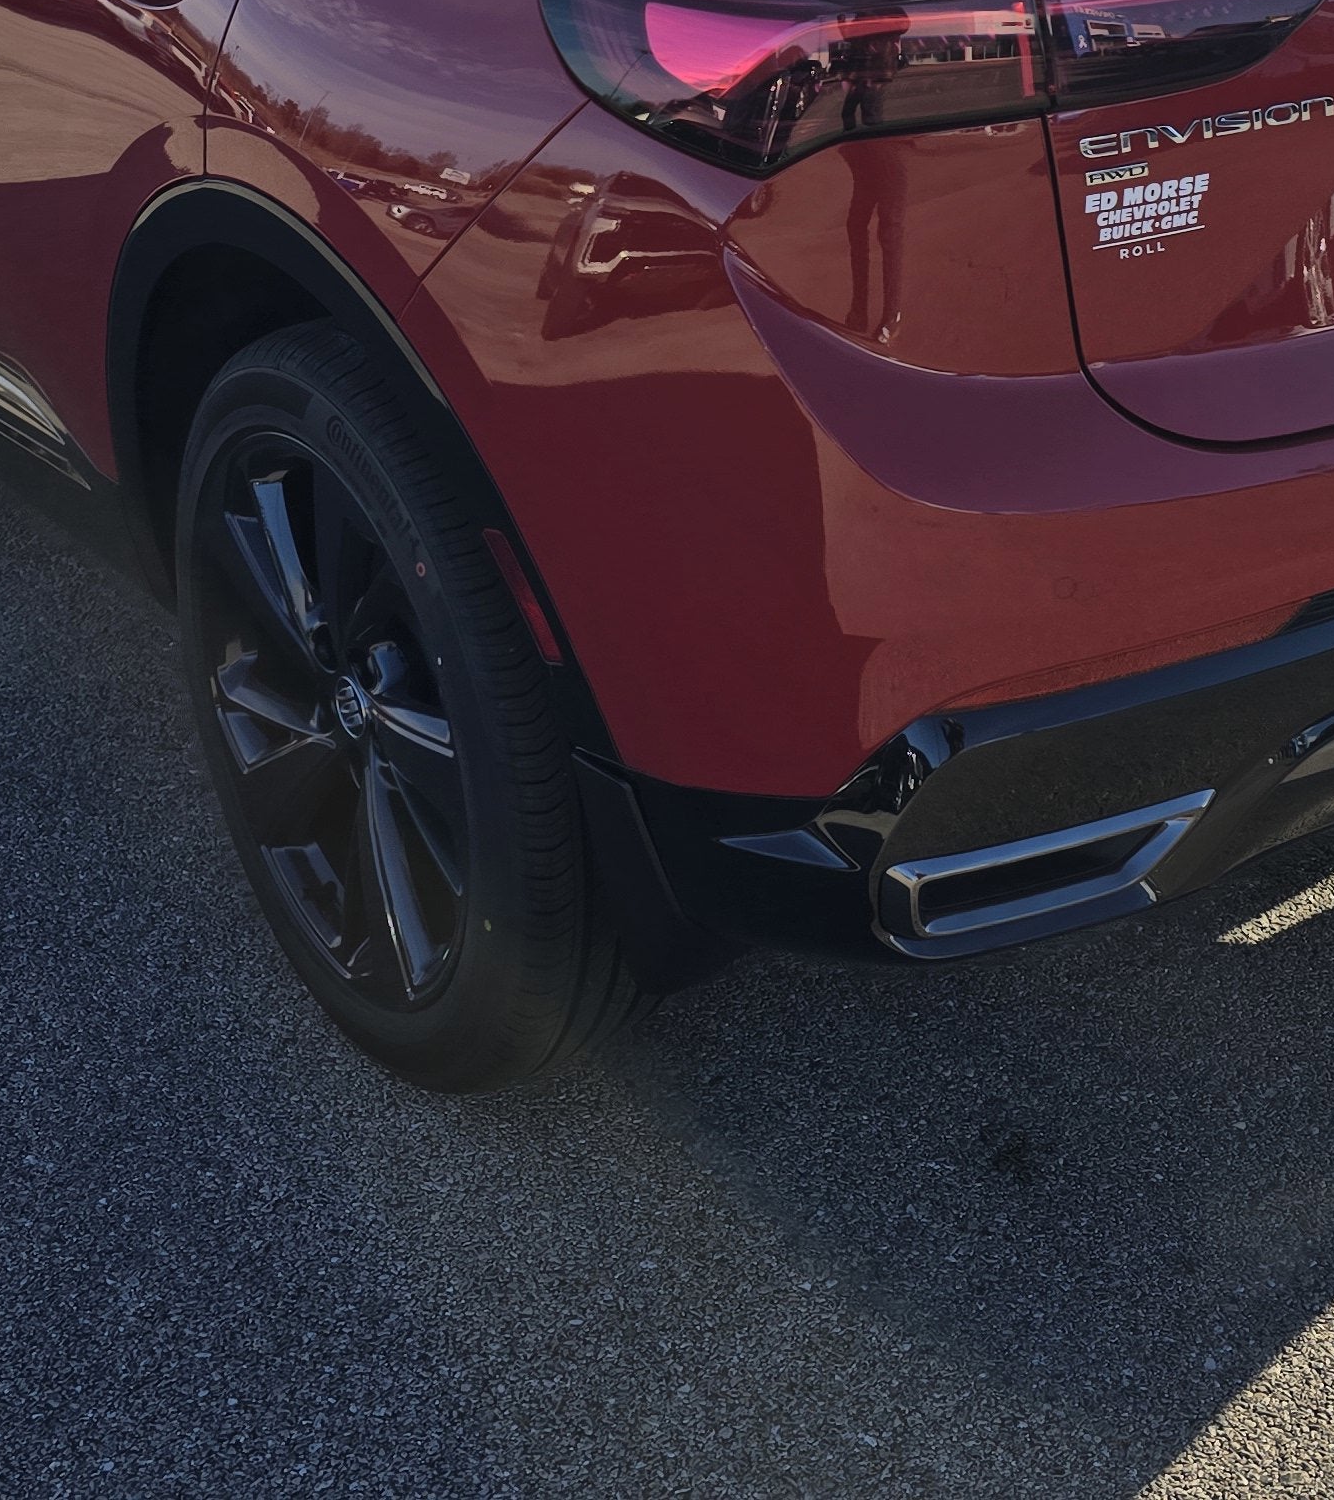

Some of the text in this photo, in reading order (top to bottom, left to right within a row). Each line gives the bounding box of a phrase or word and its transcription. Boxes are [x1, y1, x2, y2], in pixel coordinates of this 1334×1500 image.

[1079, 96, 1334, 159] ENVISION
[1086, 163, 1148, 185] AWD
[1085, 173, 1210, 214] ED MORSE
[1096, 193, 1204, 227] CHEVROLET
[1119, 241, 1166, 260] ROLL
